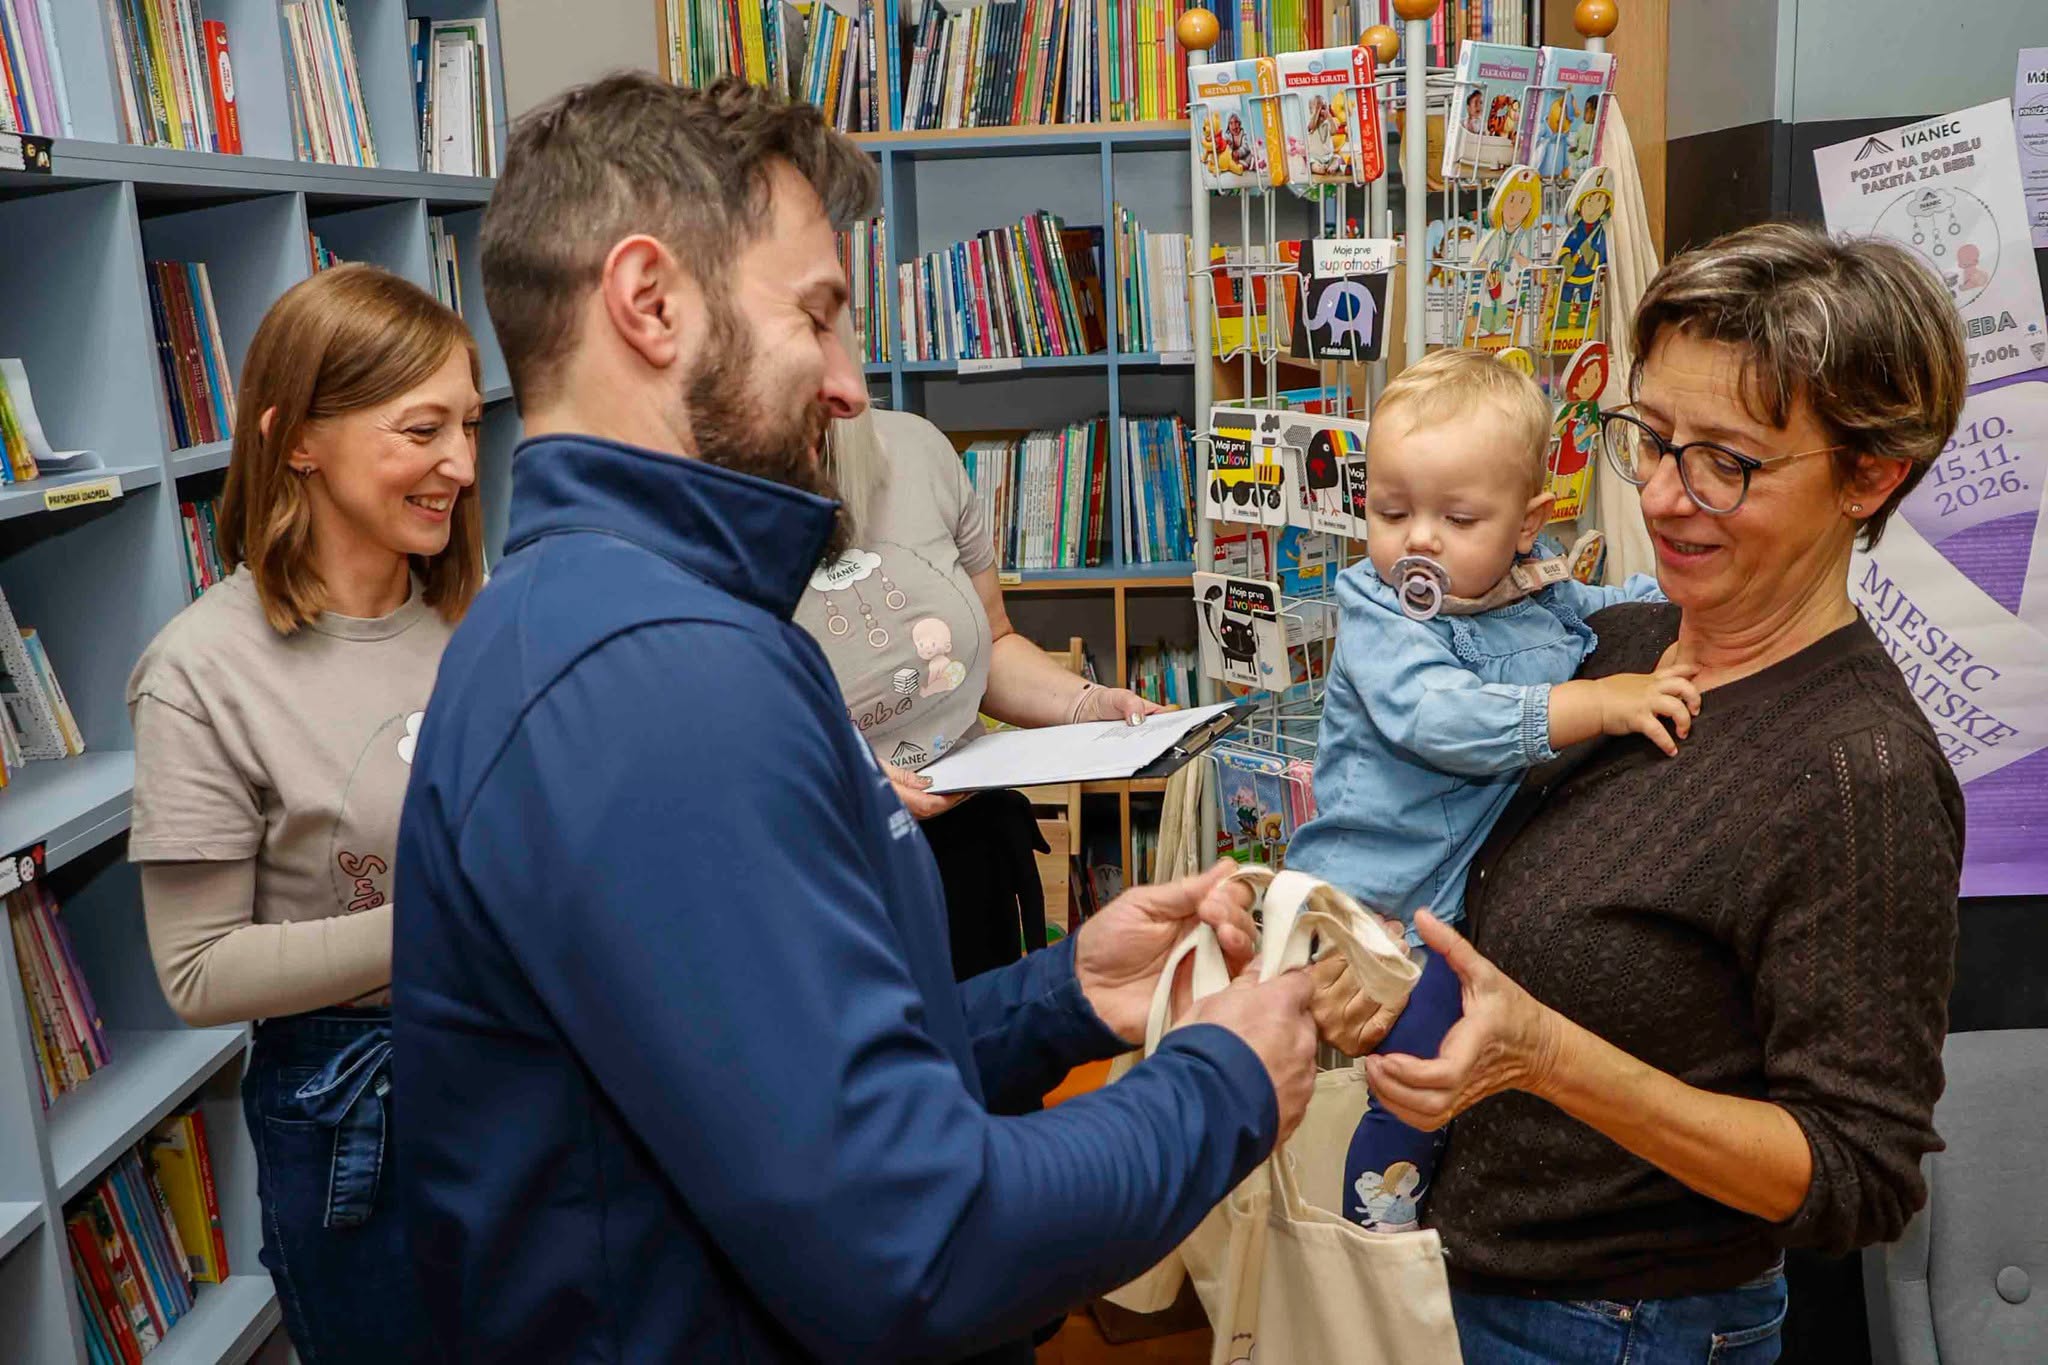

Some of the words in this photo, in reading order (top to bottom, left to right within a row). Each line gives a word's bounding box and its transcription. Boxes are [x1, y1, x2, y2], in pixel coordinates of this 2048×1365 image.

[1901, 121, 1961, 148] IVANEC
[1850, 161, 1893, 182] POZIV
[1897, 155, 1918, 170] NA
[1921, 137, 1982, 163] DODJELU
[1861, 171, 1916, 195] PAKETA
[1919, 165, 1940, 180] ZA
[1943, 154, 1976, 173] BEBE
[1320, 256, 1383, 274] suprotnosti
[1333, 245, 1352, 257] Moje
[1354, 247, 1371, 258] prve
[1967, 310, 2018, 339] EBA
[1968, 344, 2020, 369] 7:00h
[1930, 443, 2020, 488] 15.11.
[1934, 470, 2029, 517] 2026.
[827, 562, 861, 581] IVANEC
[1860, 559, 2001, 692] MJESEC
